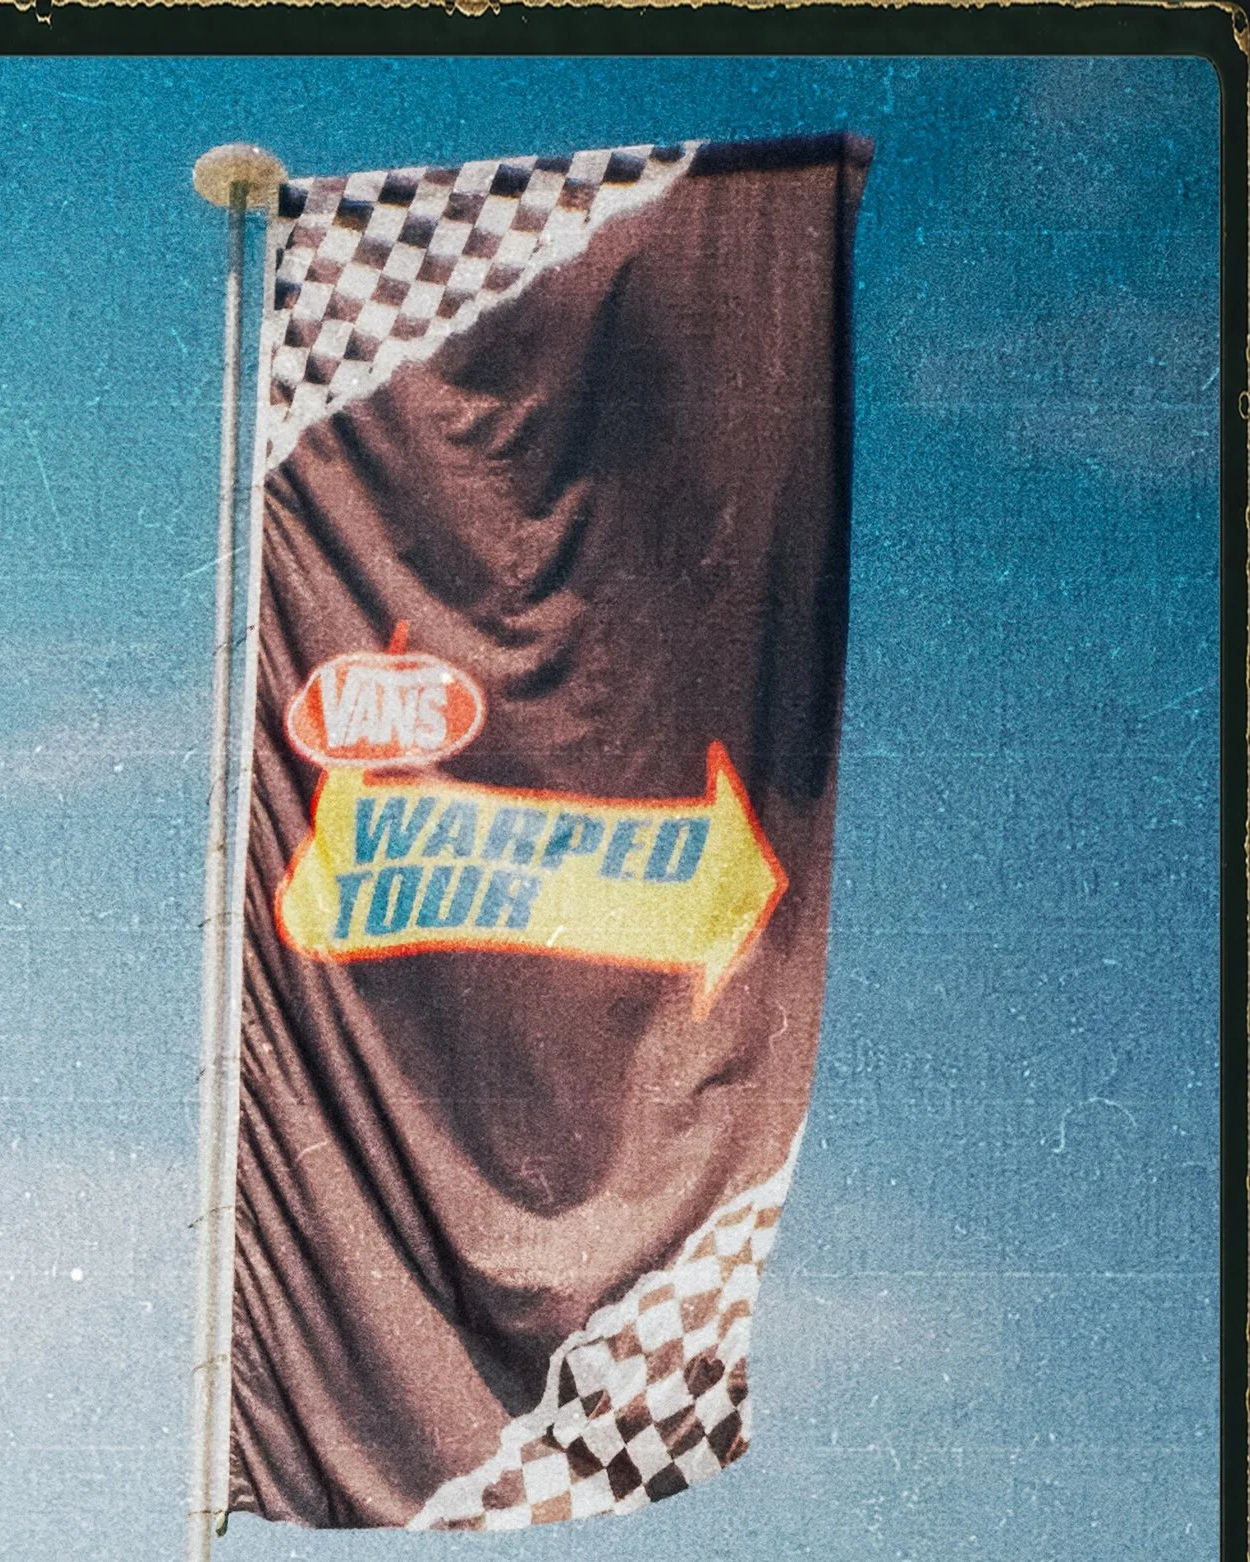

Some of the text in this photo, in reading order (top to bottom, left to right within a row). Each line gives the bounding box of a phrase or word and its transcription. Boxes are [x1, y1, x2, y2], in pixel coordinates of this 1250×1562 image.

[318, 663, 448, 750] VANS
[353, 795, 711, 884] WARPED
[332, 864, 543, 941] TOUR
